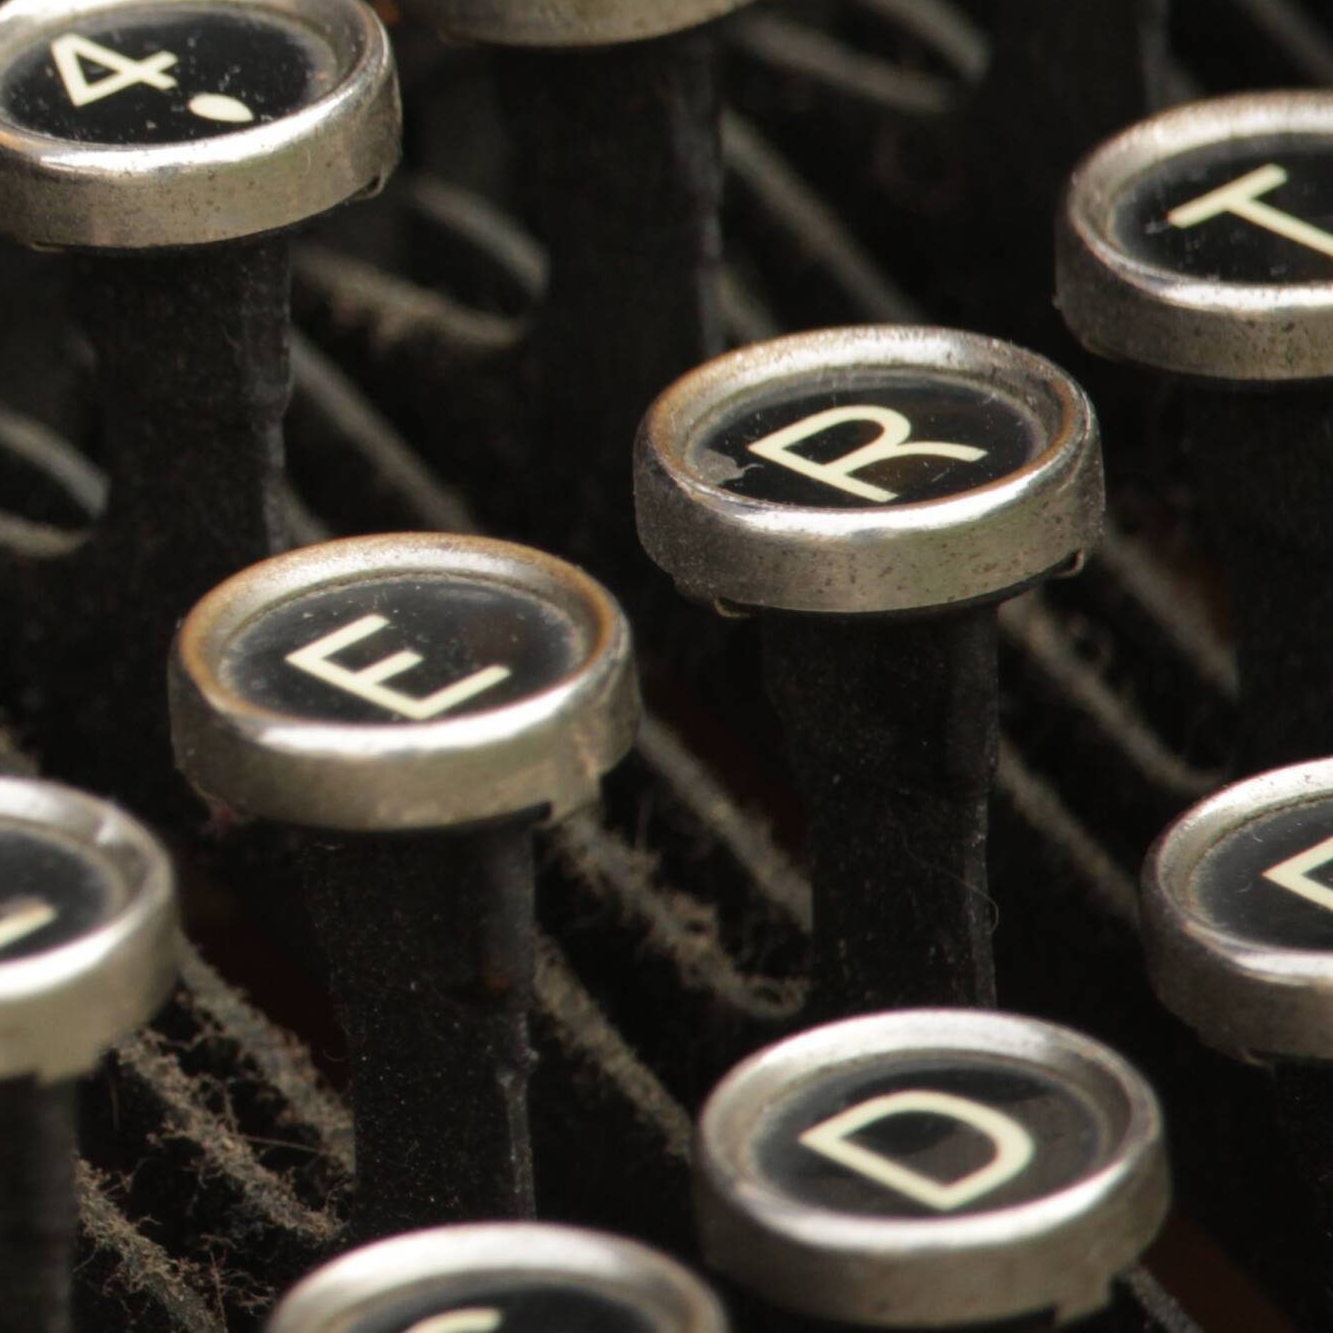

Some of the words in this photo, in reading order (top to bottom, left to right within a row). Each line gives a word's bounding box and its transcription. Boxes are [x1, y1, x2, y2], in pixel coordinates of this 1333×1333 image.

[48, 33, 181, 107] 4
[1166, 164, 1333, 261] T
[746, 404, 989, 503] R
[284, 612, 513, 721] E
[797, 1088, 1037, 1211] D
